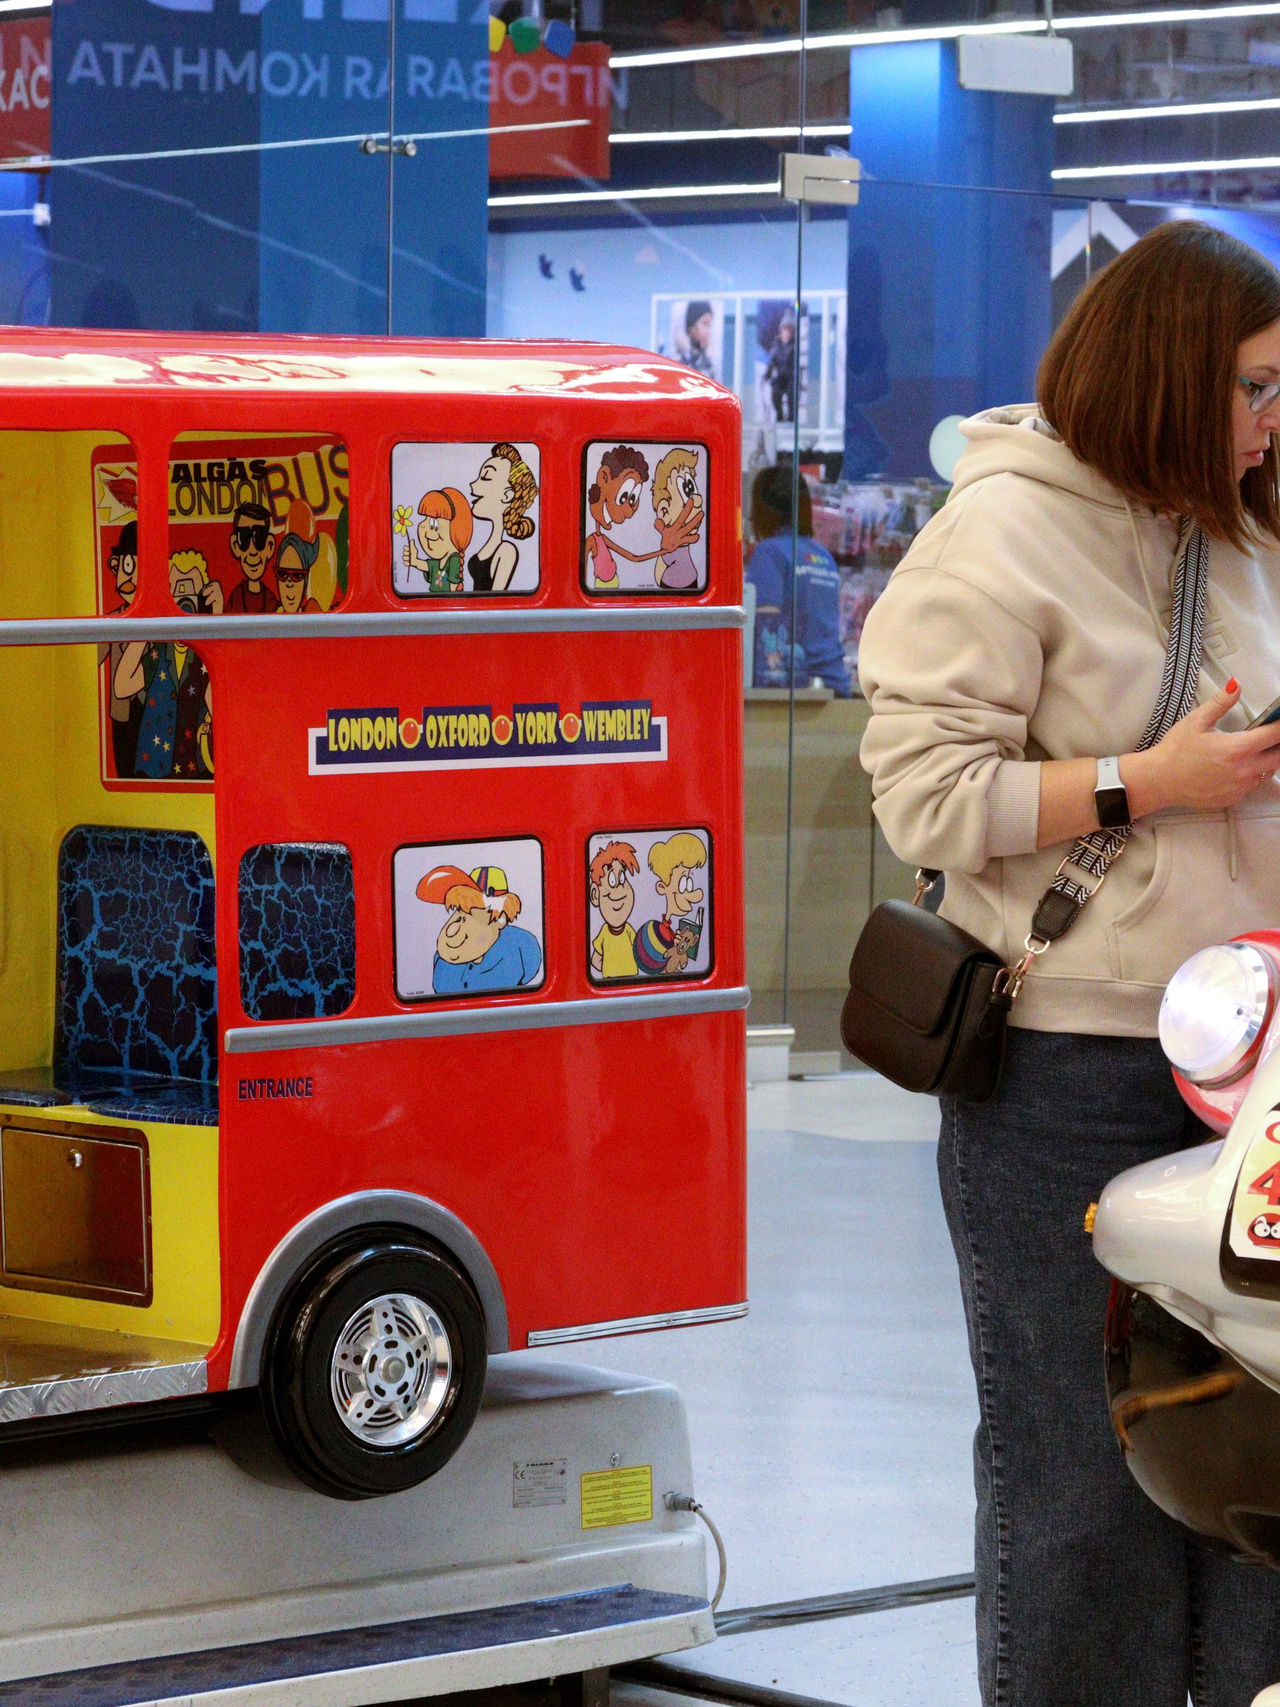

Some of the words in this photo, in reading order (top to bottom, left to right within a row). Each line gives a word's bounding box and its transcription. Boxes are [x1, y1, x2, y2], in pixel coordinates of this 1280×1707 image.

[328, 716, 398, 752] LONDON
[426, 713, 490, 749] OXFORD
[516, 711, 558, 745] YORK
[582, 708, 651, 742] WEMBLEY
[238, 1077, 313, 1100] ENTRANCE
